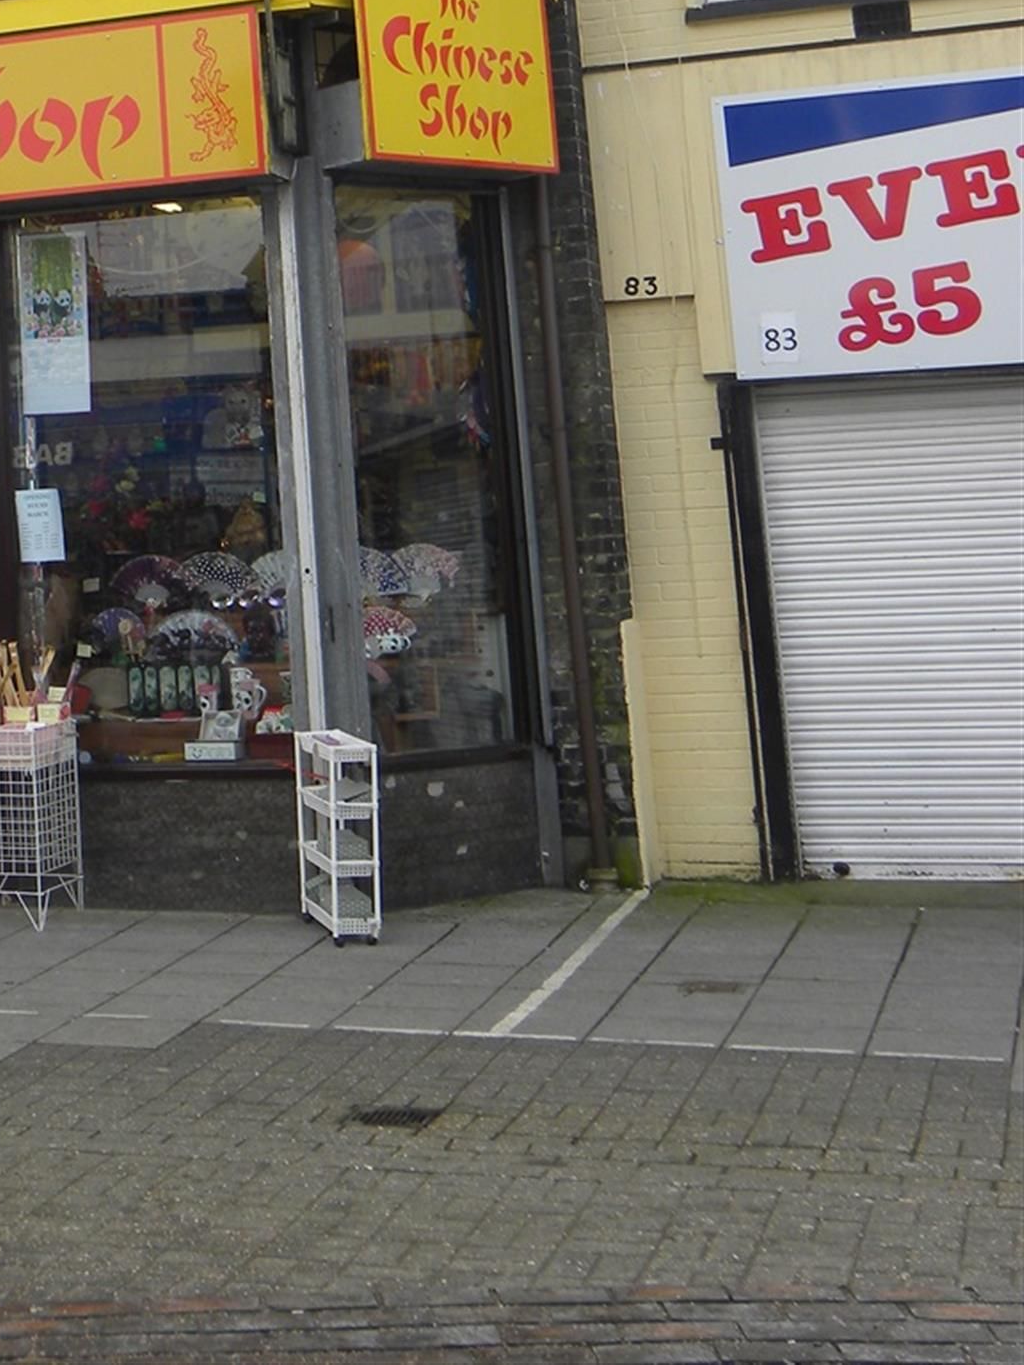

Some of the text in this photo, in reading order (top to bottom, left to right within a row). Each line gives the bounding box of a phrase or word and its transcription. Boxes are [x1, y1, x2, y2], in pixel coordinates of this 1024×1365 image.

[382, 15, 534, 87] Chinese
[419, 83, 513, 156] Shop
[740, 145, 1024, 264] EVE
[624, 276, 659, 297] 83
[837, 260, 983, 353] £5
[764, 328, 798, 352] 83
